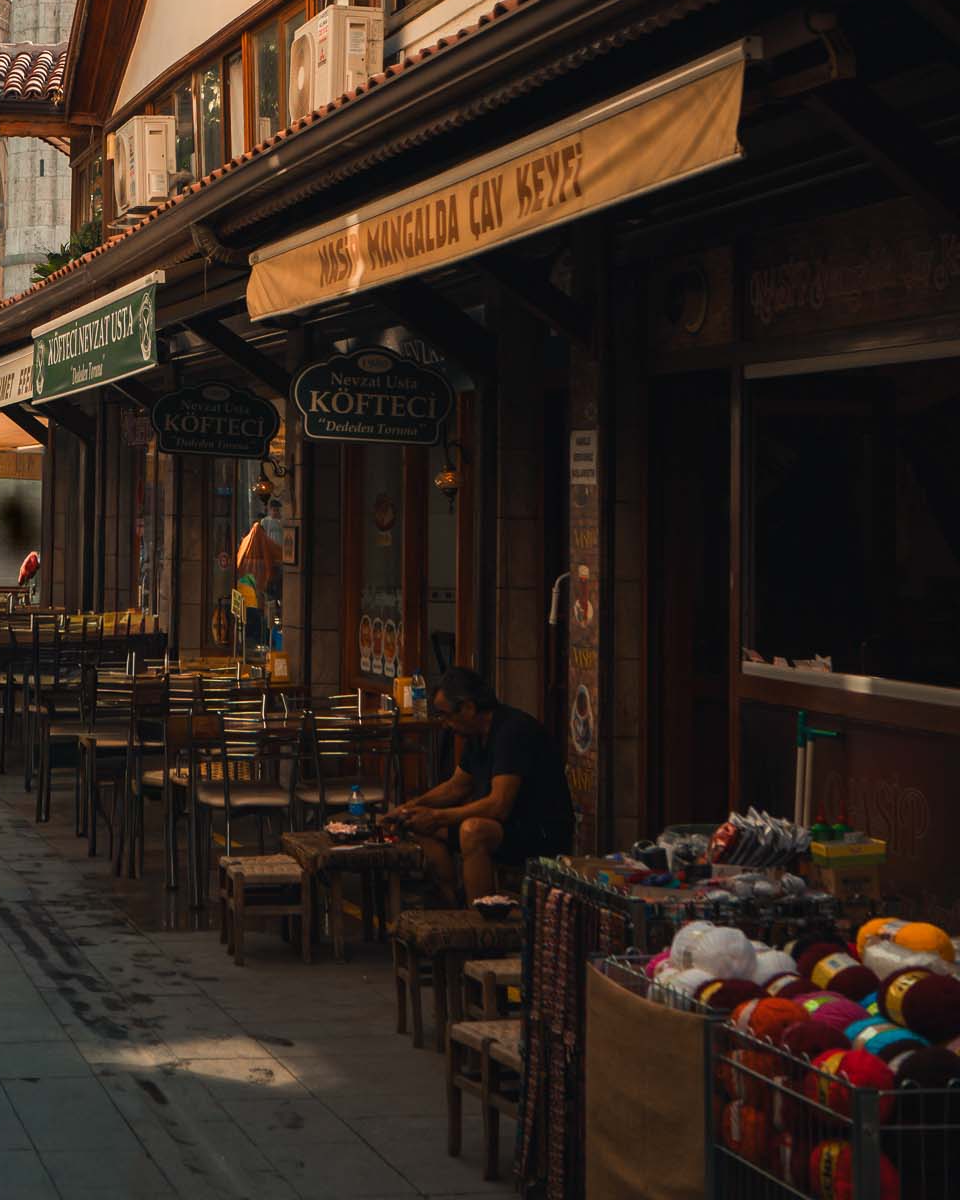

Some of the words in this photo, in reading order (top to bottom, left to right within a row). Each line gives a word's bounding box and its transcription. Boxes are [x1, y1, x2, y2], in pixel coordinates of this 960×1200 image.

[367, 194, 461, 270] MANGALDA
[469, 173, 504, 241] ÇAY
[516, 141, 583, 218] KEYFİ
[47, 321, 78, 367] KÖFTECİ
[78, 314, 110, 355] NEVZAT
[110, 304, 134, 343] USTA
[309, 387, 438, 419] KÖFTECİ
